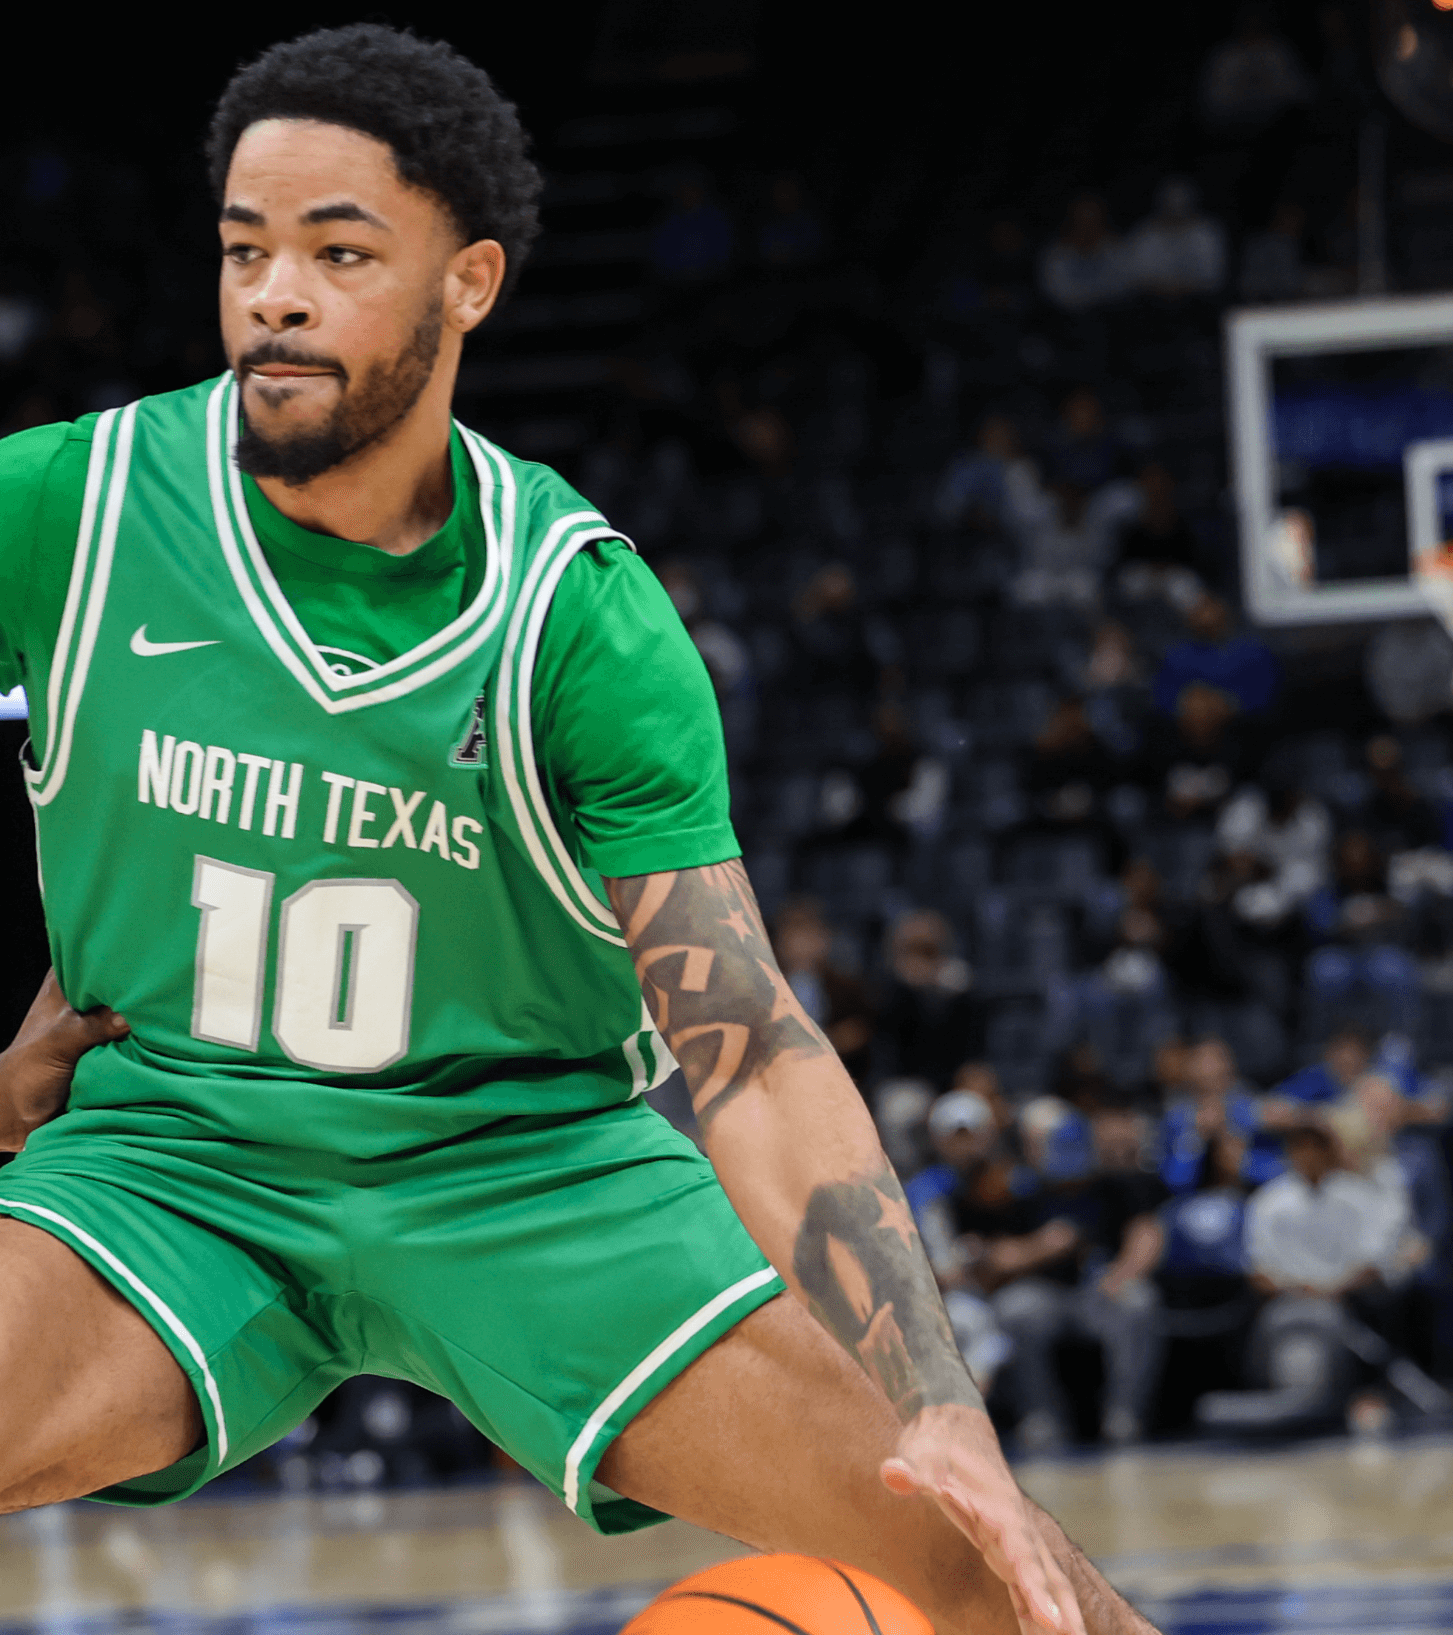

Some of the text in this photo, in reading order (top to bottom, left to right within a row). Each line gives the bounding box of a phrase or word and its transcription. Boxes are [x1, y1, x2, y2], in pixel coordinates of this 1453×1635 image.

[138, 730, 484, 870] NORTH TEXAS
[191, 854, 420, 1074] 10
